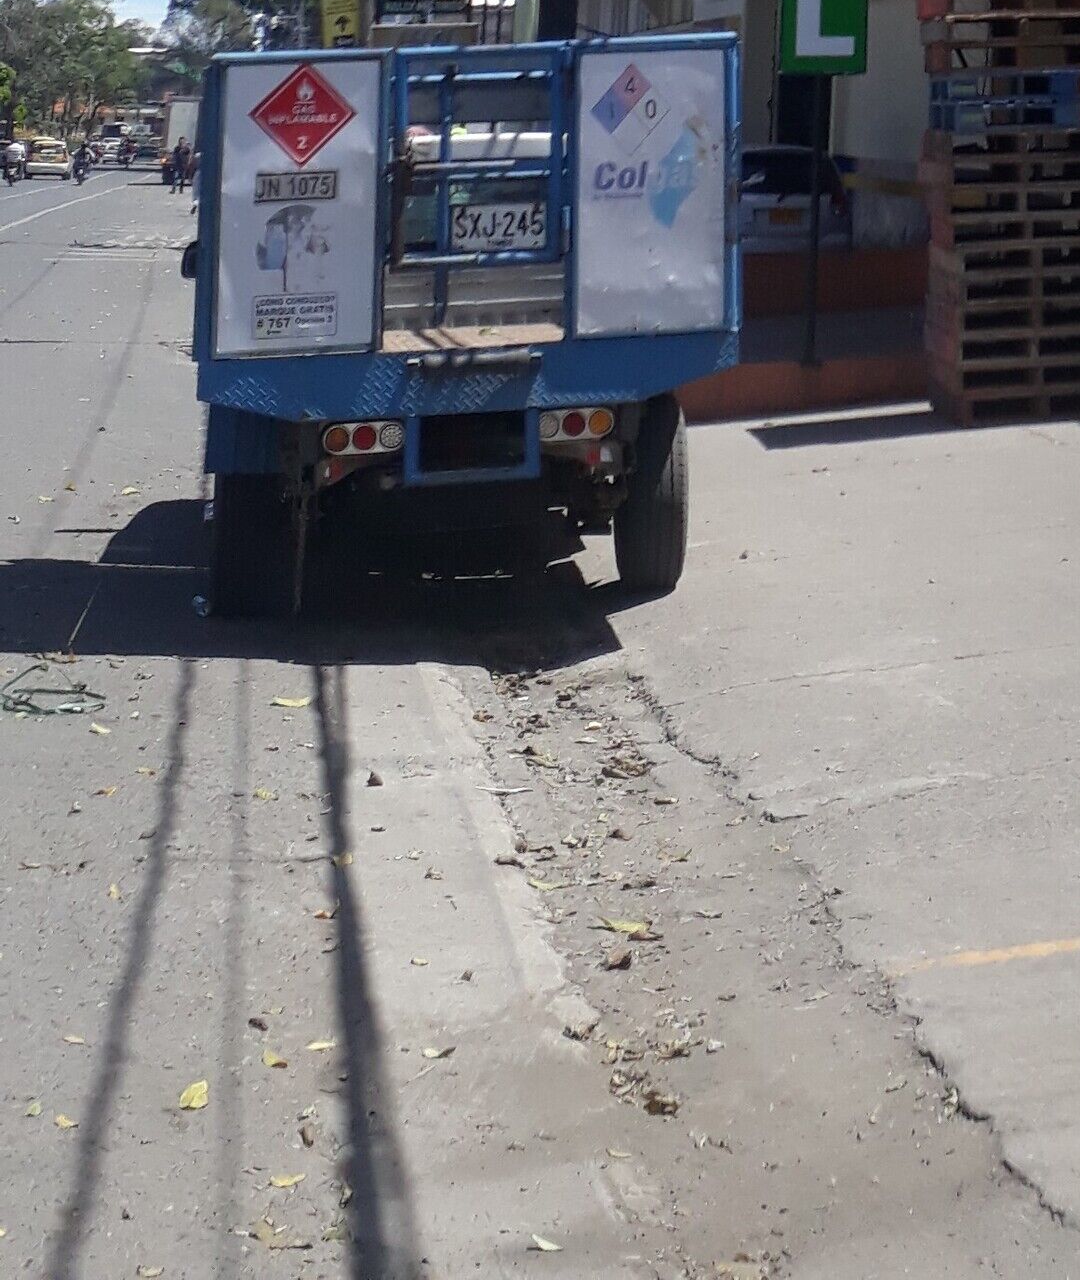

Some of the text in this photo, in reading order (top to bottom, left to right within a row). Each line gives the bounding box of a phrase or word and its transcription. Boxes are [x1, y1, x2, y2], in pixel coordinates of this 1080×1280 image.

[645, 99, 657, 120] 0
[296, 135, 309, 150] 2
[288, 175, 332, 197] 1075
